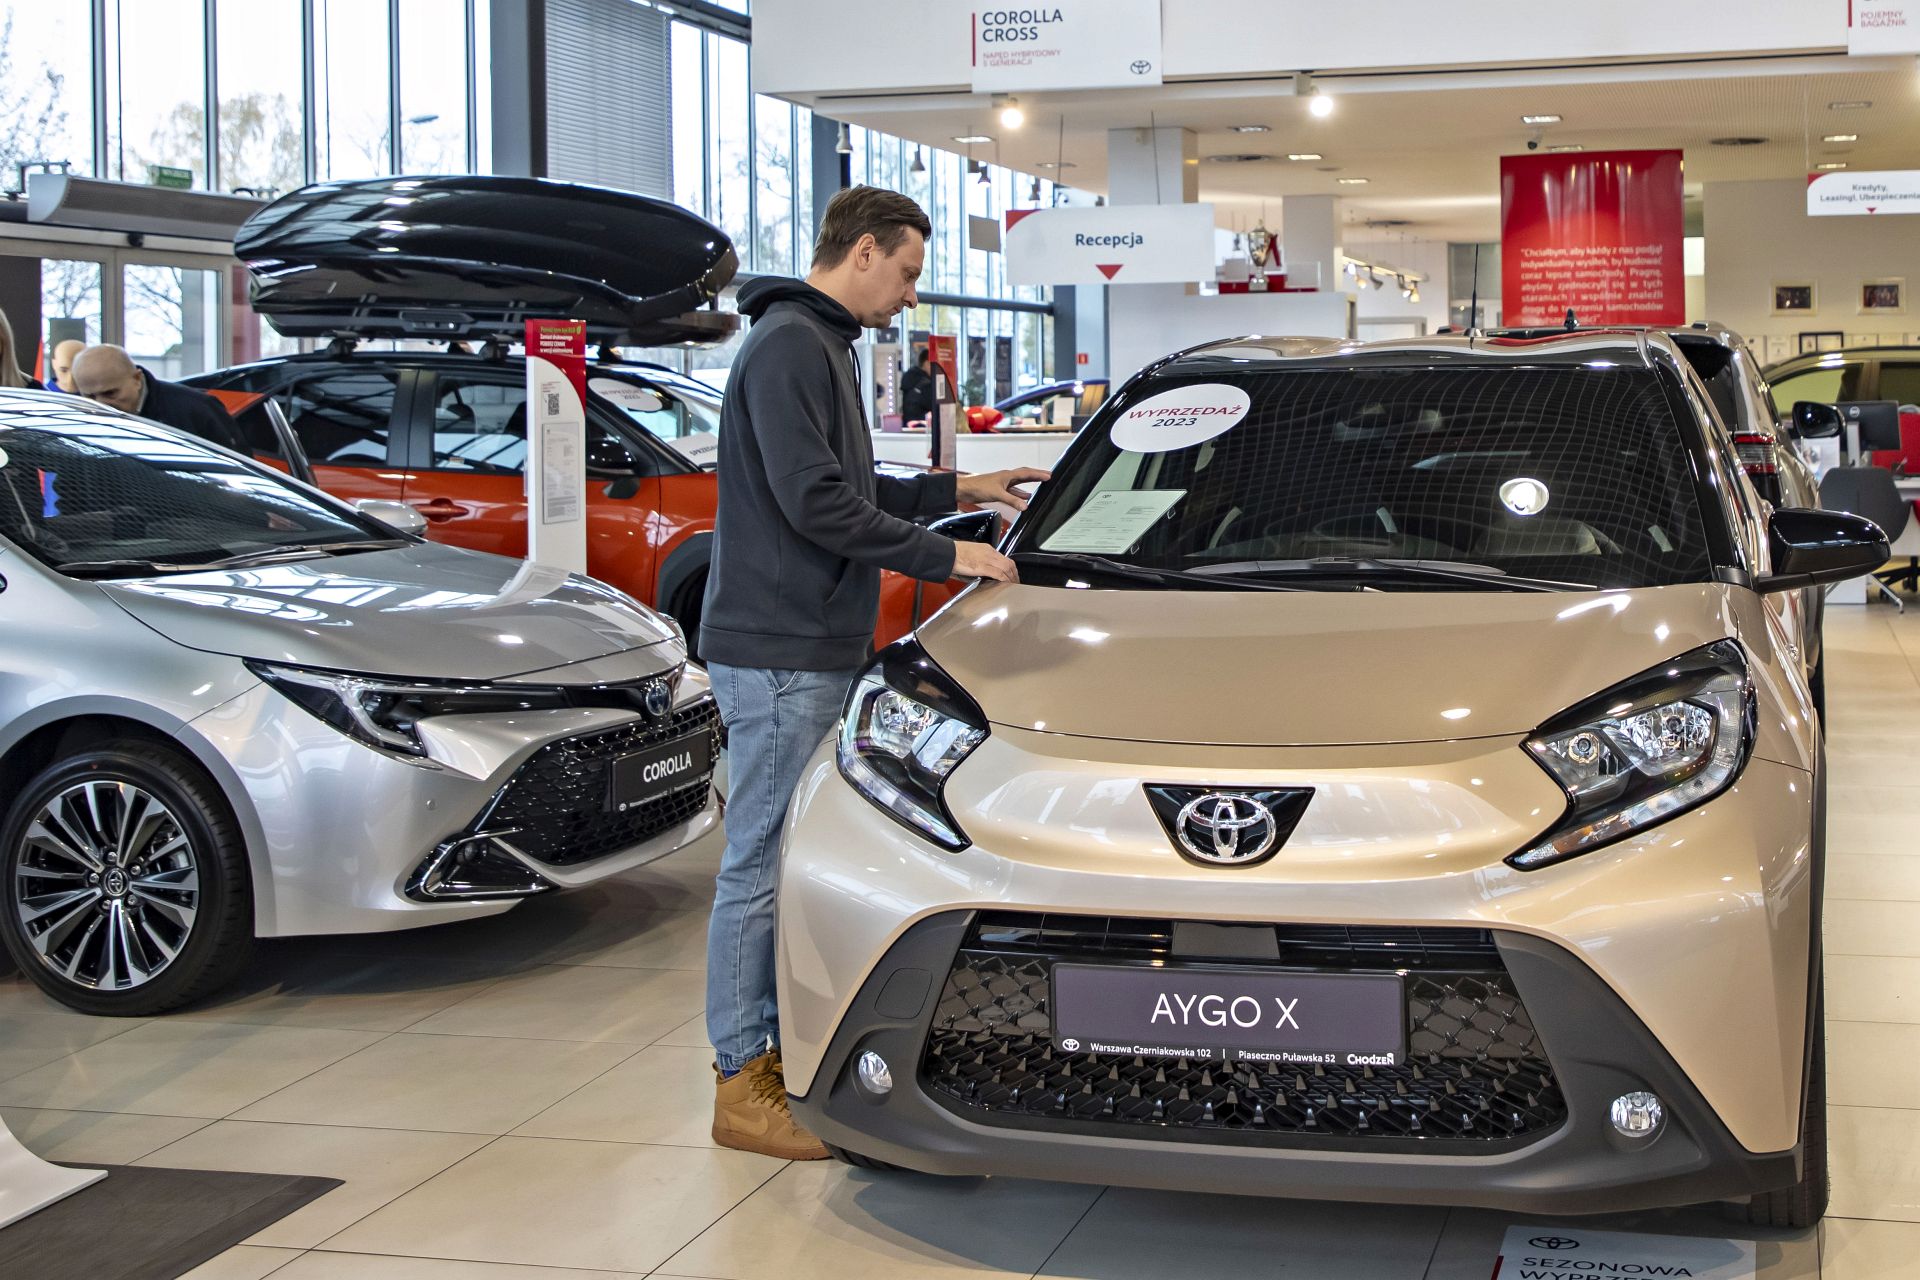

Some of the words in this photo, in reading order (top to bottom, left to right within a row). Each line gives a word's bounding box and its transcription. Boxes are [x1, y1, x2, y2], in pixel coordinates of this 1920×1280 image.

[982, 9, 1063, 26] COROLLA
[1860, 10, 1903, 20] POJEMNY
[982, 27, 1039, 42] CROSS
[1011, 49, 1061, 58] HYBRYDOWY
[990, 58, 1032, 66] GENERACJI
[1075, 232, 1144, 248] Recepcja
[1619, 246, 1634, 254] nas
[1521, 259, 1575, 269] indywidualny
[1611, 257, 1622, 267] by
[1545, 270, 1571, 280] lepsze
[1643, 279, 1663, 289] tych
[1521, 293, 1568, 303] staraniach
[1548, 303, 1559, 313] do
[1606, 301, 1664, 312] samochodów
[1129, 405, 1242, 420] WYPRZEDAŻ
[1152, 417, 1197, 428] 2023
[643, 751, 692, 782] COROLLA
[1150, 993, 1262, 1028] AYGO
[1275, 997, 1299, 1030] X
[1090, 1042, 1132, 1054] Warszawa
[1133, 1045, 1195, 1057] Czerniakowska
[1196, 1049, 1212, 1058] 102
[1238, 1050, 1281, 1061] Piaseczno
[1282, 1053, 1323, 1063] Puławska
[1324, 1054, 1336, 1063] 52
[1523, 1257, 1693, 1277] SEZONOWA
